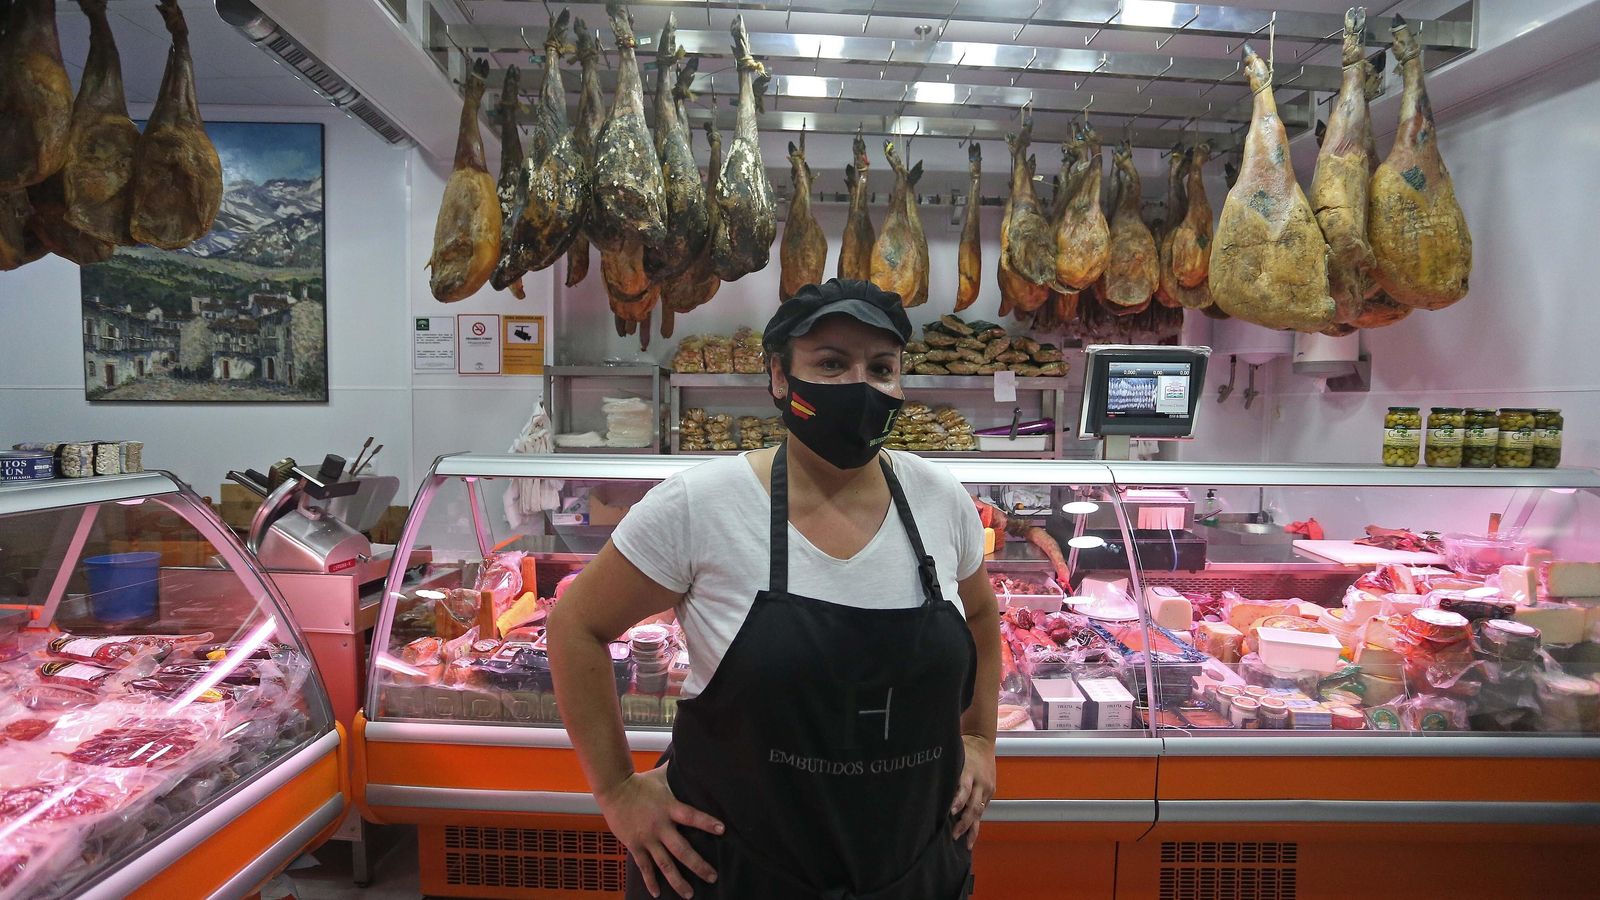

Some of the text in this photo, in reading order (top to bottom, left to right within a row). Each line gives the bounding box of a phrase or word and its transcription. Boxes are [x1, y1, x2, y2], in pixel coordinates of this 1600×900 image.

[2, 467, 24, 476] ÚN
[768, 746, 943, 776] EMBUTIDOS GUIJUELO
